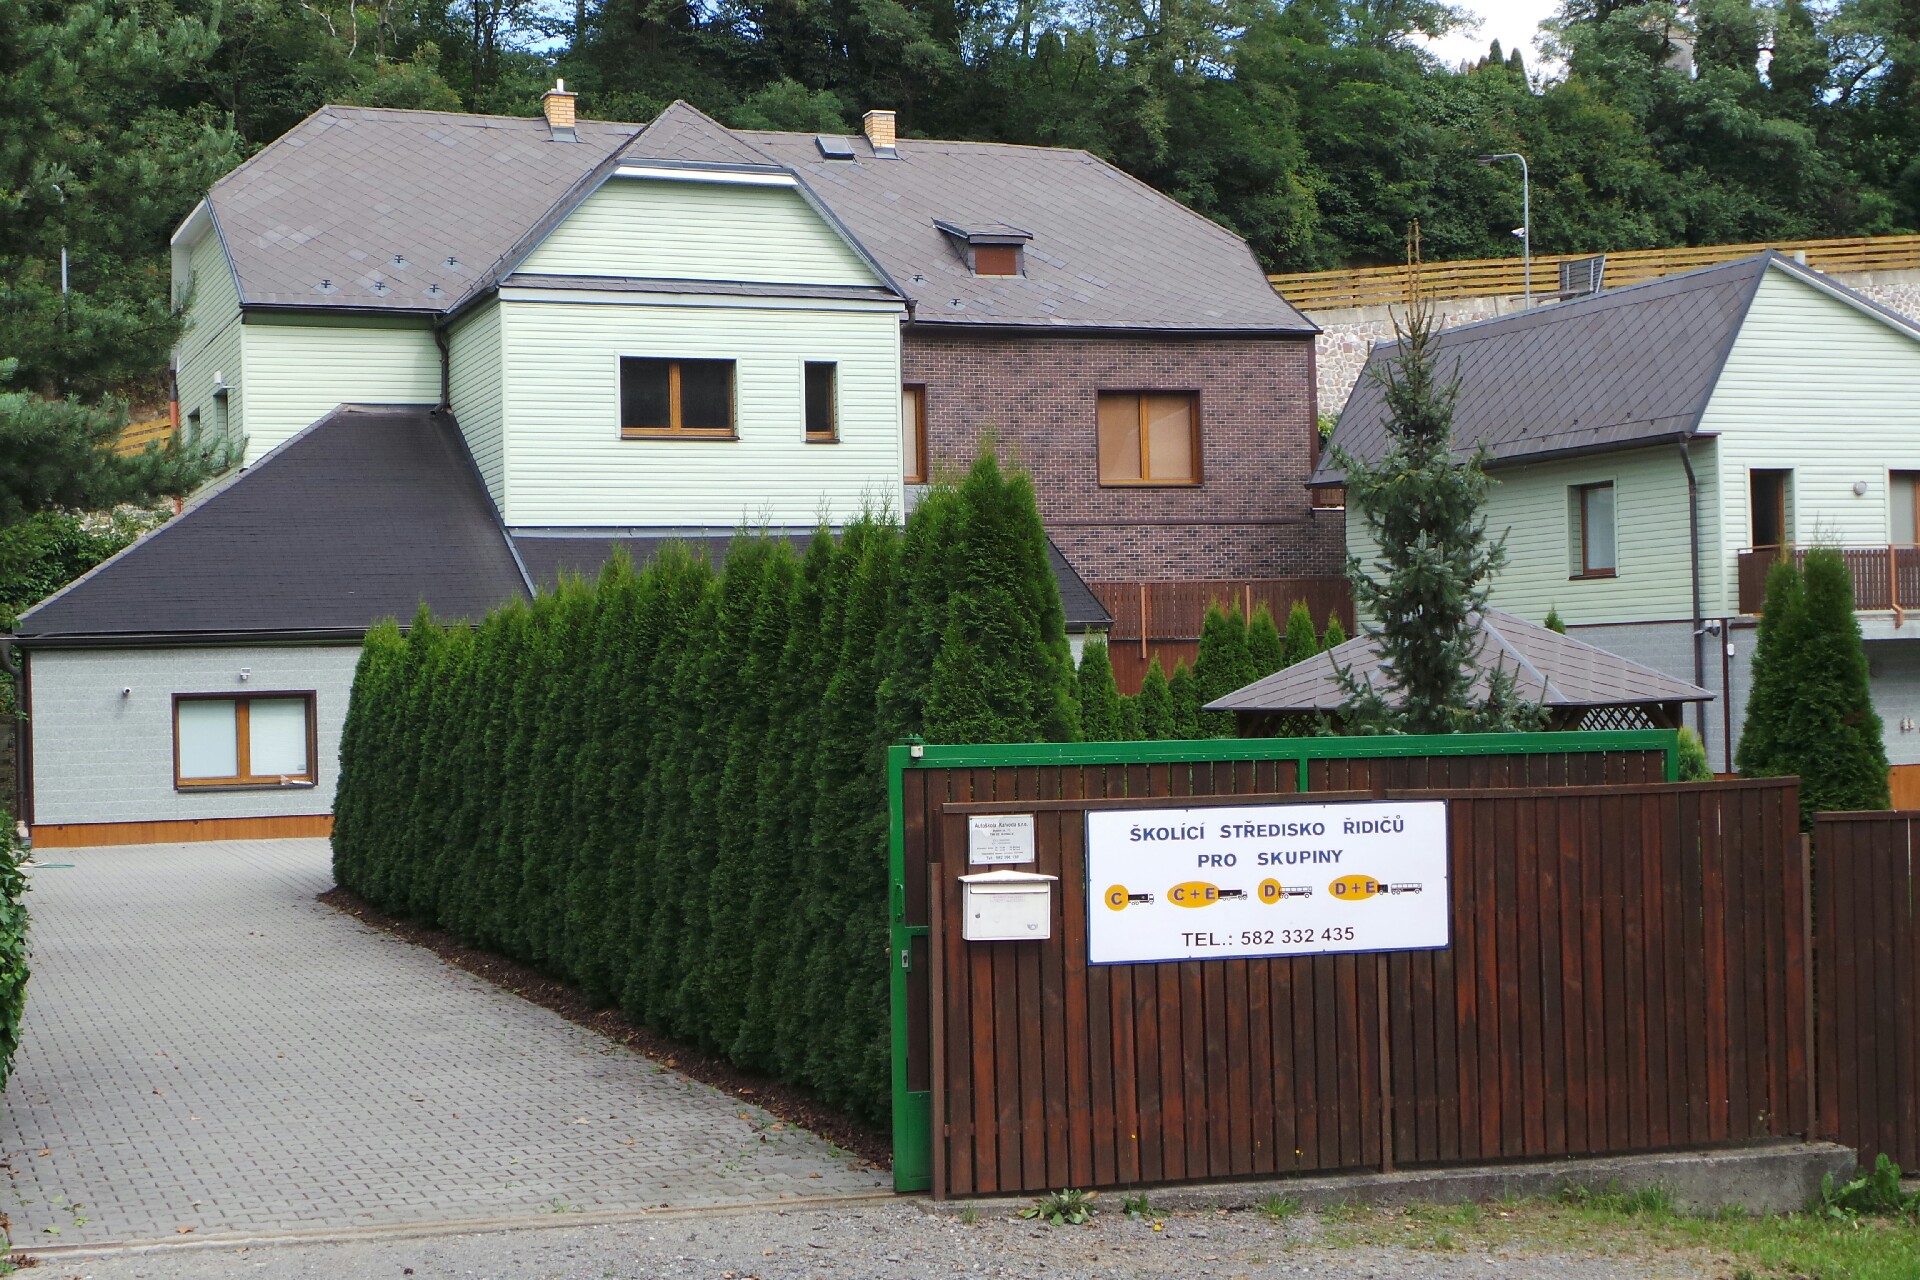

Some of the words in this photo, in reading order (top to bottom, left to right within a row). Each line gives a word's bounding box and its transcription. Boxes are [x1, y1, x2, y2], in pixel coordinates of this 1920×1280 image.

[1129, 822, 1205, 842] ŠKOLÍCÍ
[1219, 820, 1326, 839] STŘEDISKO
[1343, 815, 1404, 835] ŘIDIČŮ
[1197, 853, 1237, 868] PRO
[1257, 850, 1343, 866] SKUPINY
[1110, 892, 1123, 905] C
[1264, 884, 1276, 897] D
[1181, 932, 1233, 947] TEL.:
[1240, 930, 1275, 945] 582
[1281, 928, 1314, 944] 332
[1321, 927, 1355, 942] 435
